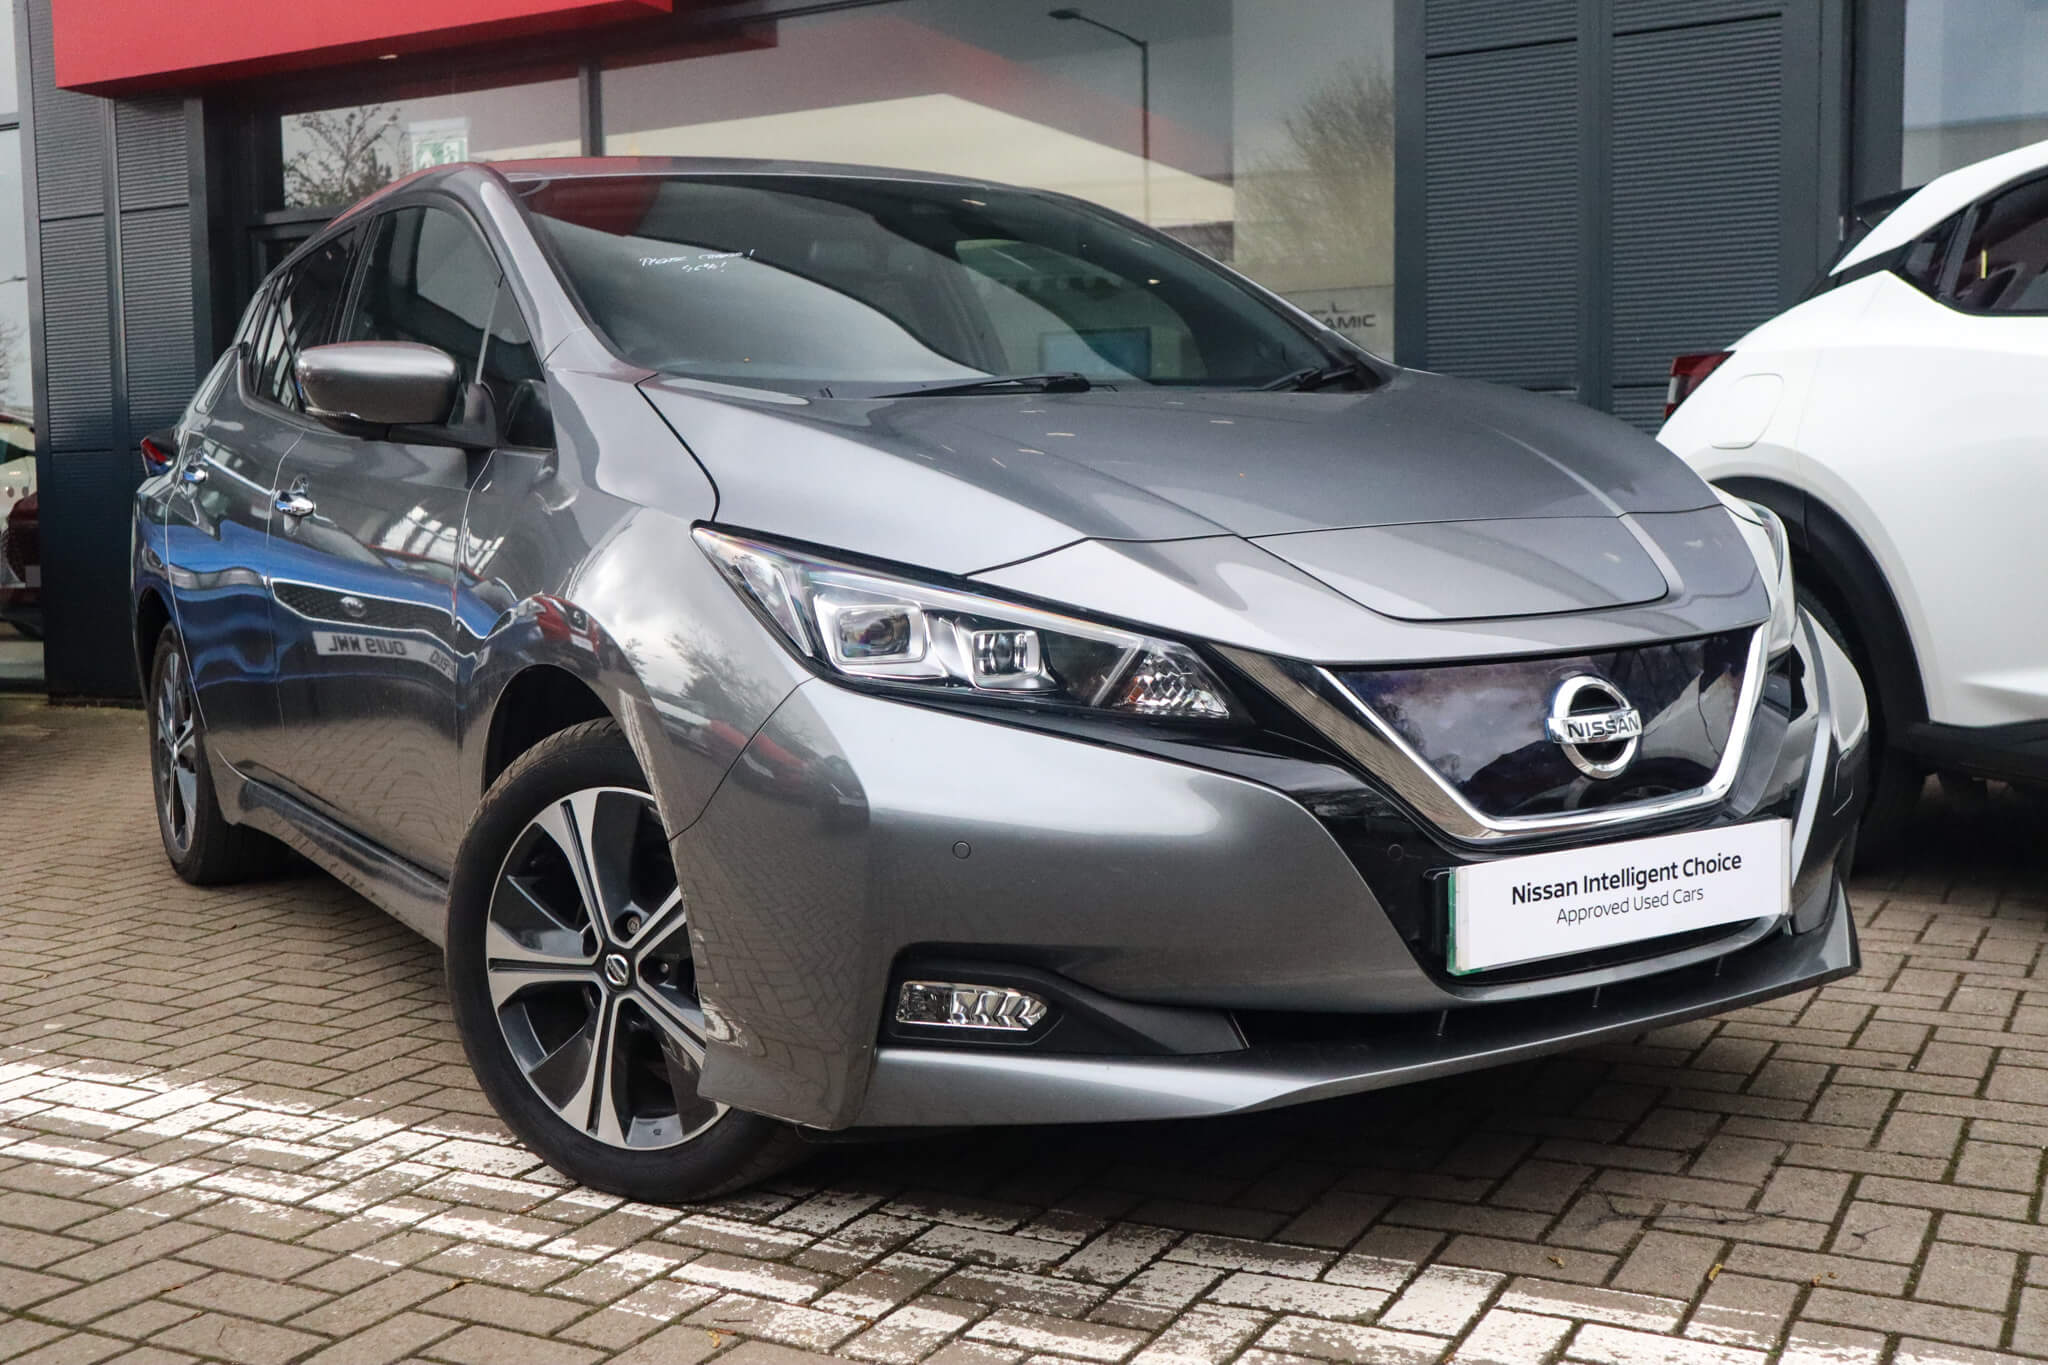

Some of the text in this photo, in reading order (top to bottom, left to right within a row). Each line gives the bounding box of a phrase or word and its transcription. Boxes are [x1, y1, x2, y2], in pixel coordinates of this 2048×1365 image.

[1325, 314, 1376, 328] AMIC
[1567, 711, 1640, 738] NISSAN
[1512, 853, 1742, 905] Nissan Intelligent Choice
[1556, 887, 1704, 926] Approved Used Cars
